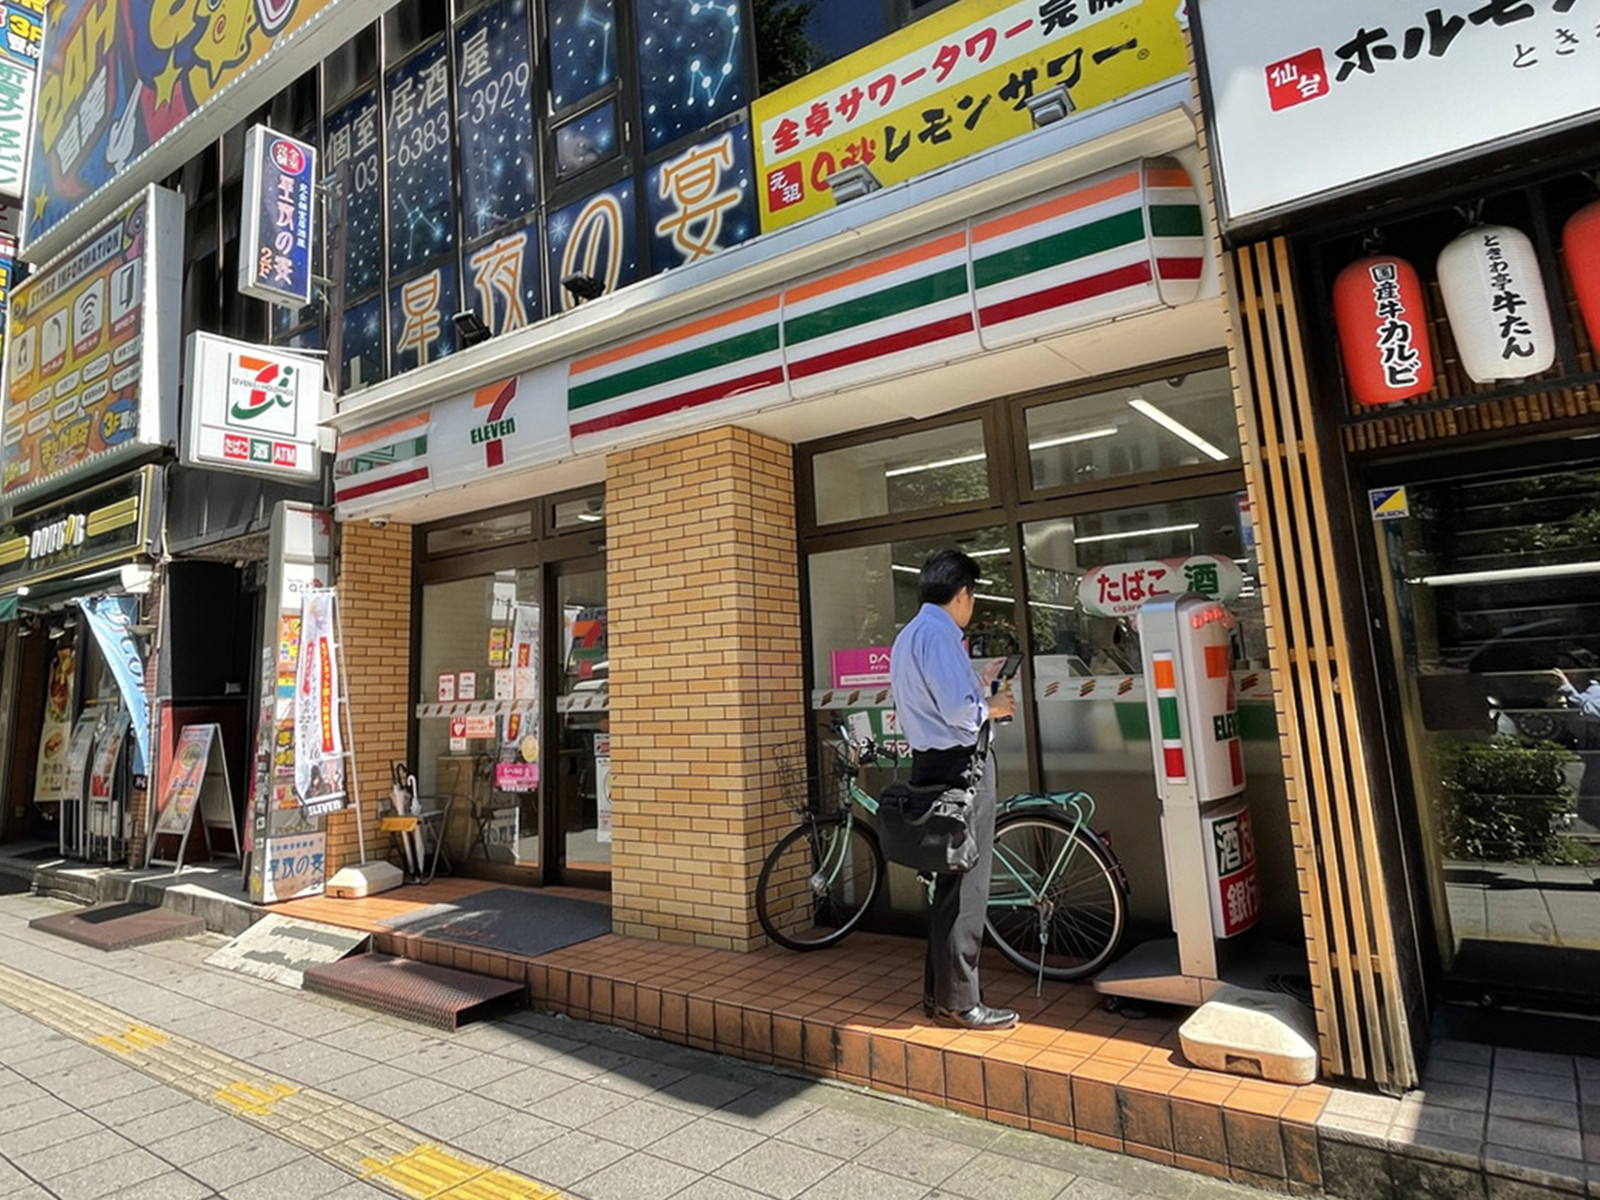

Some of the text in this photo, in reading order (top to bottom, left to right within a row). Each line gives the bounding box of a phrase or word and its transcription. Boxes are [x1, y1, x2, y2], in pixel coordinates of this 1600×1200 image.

[1335, 0, 1576, 82] ホルモ
[772, 0, 1124, 154] 全卓サワータワー完
[1270, 63, 1321, 98] 仙台
[769, 171, 802, 204] 元祖
[1097, 569, 1170, 604] たばこ
[1184, 563, 1219, 594] 酒
[1215, 821, 1241, 874] 酒
